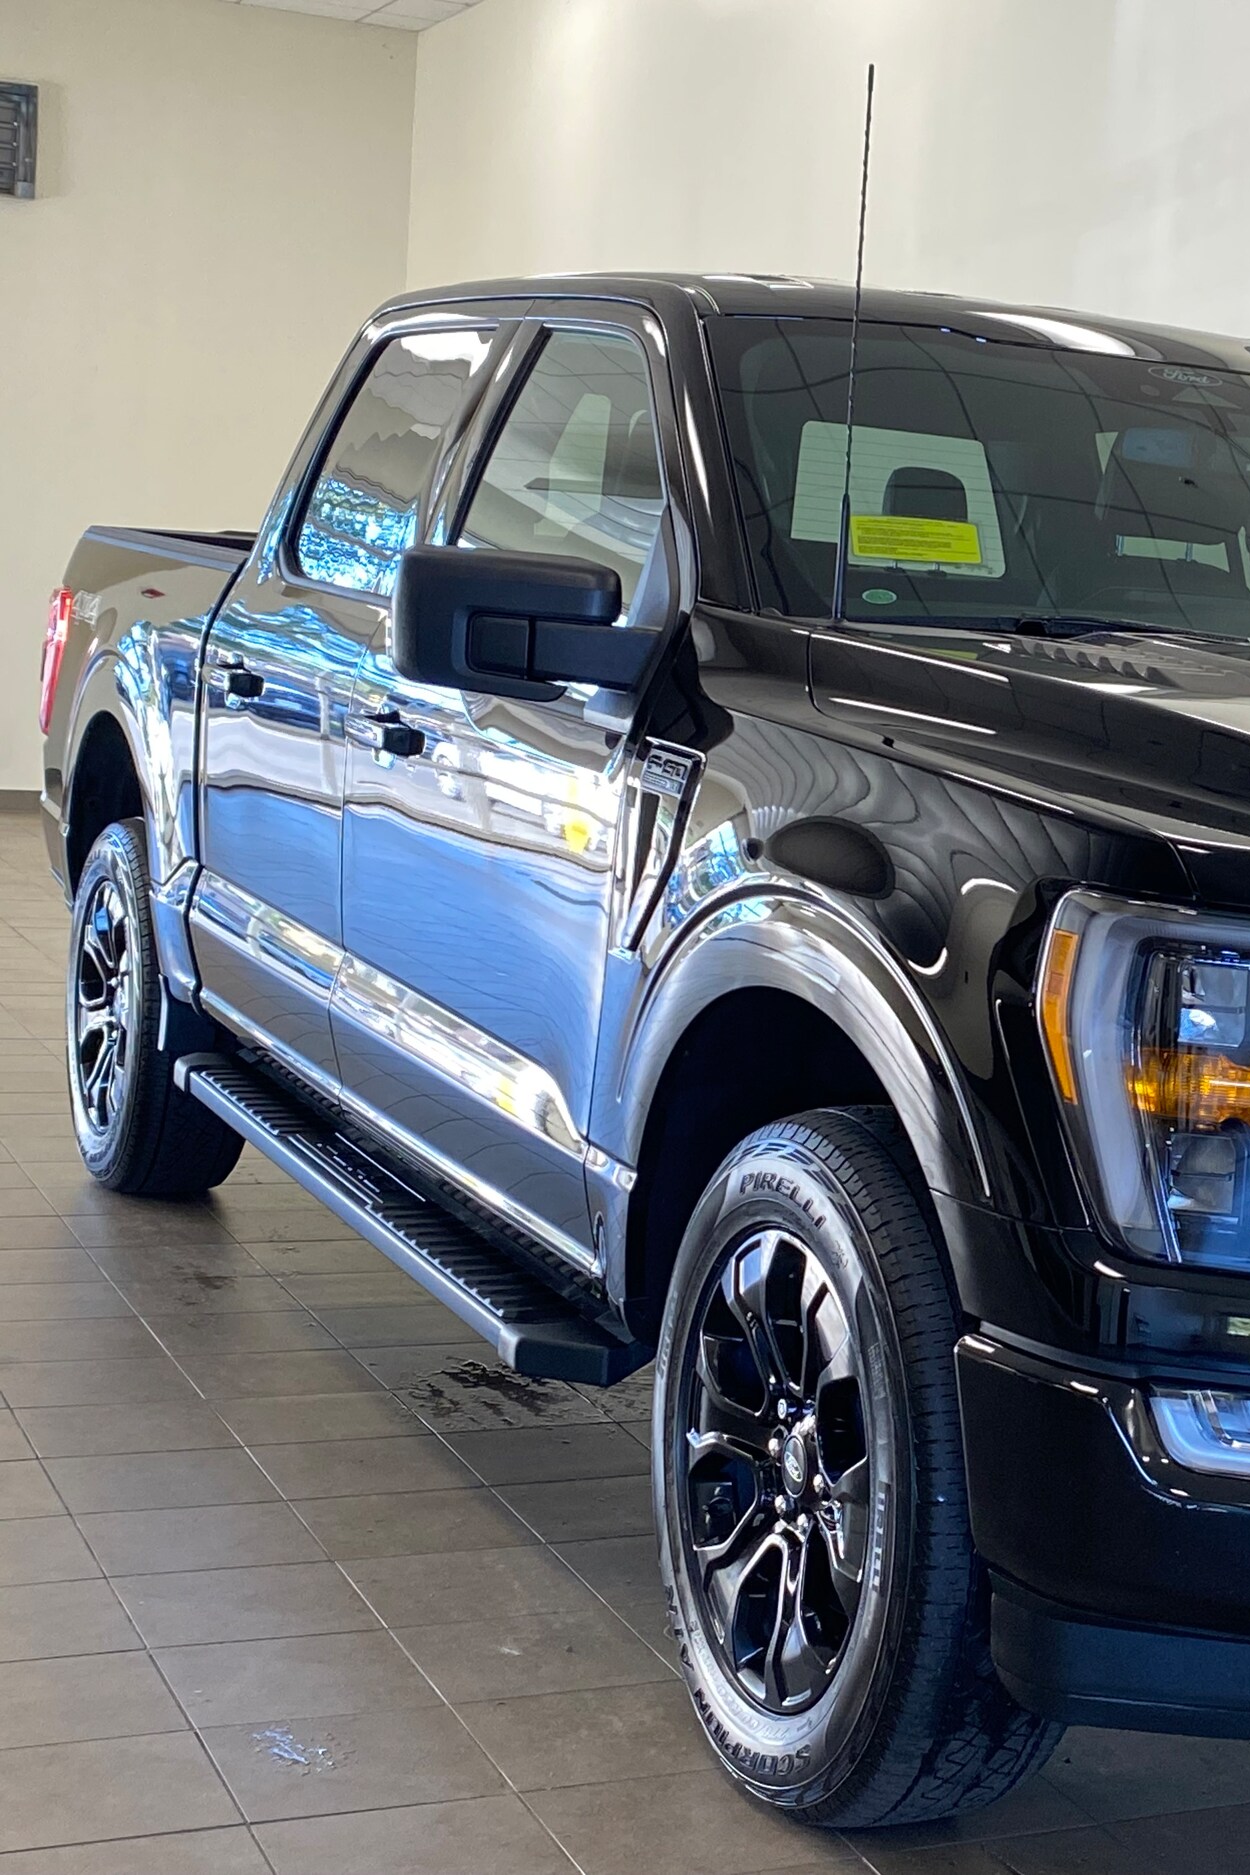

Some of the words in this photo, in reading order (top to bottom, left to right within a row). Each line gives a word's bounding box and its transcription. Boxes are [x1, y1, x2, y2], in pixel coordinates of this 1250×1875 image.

[1162, 367, 1211, 384] Ford
[739, 1171, 827, 1231] PIRELLI
[693, 1687, 812, 1777] SCORPION
